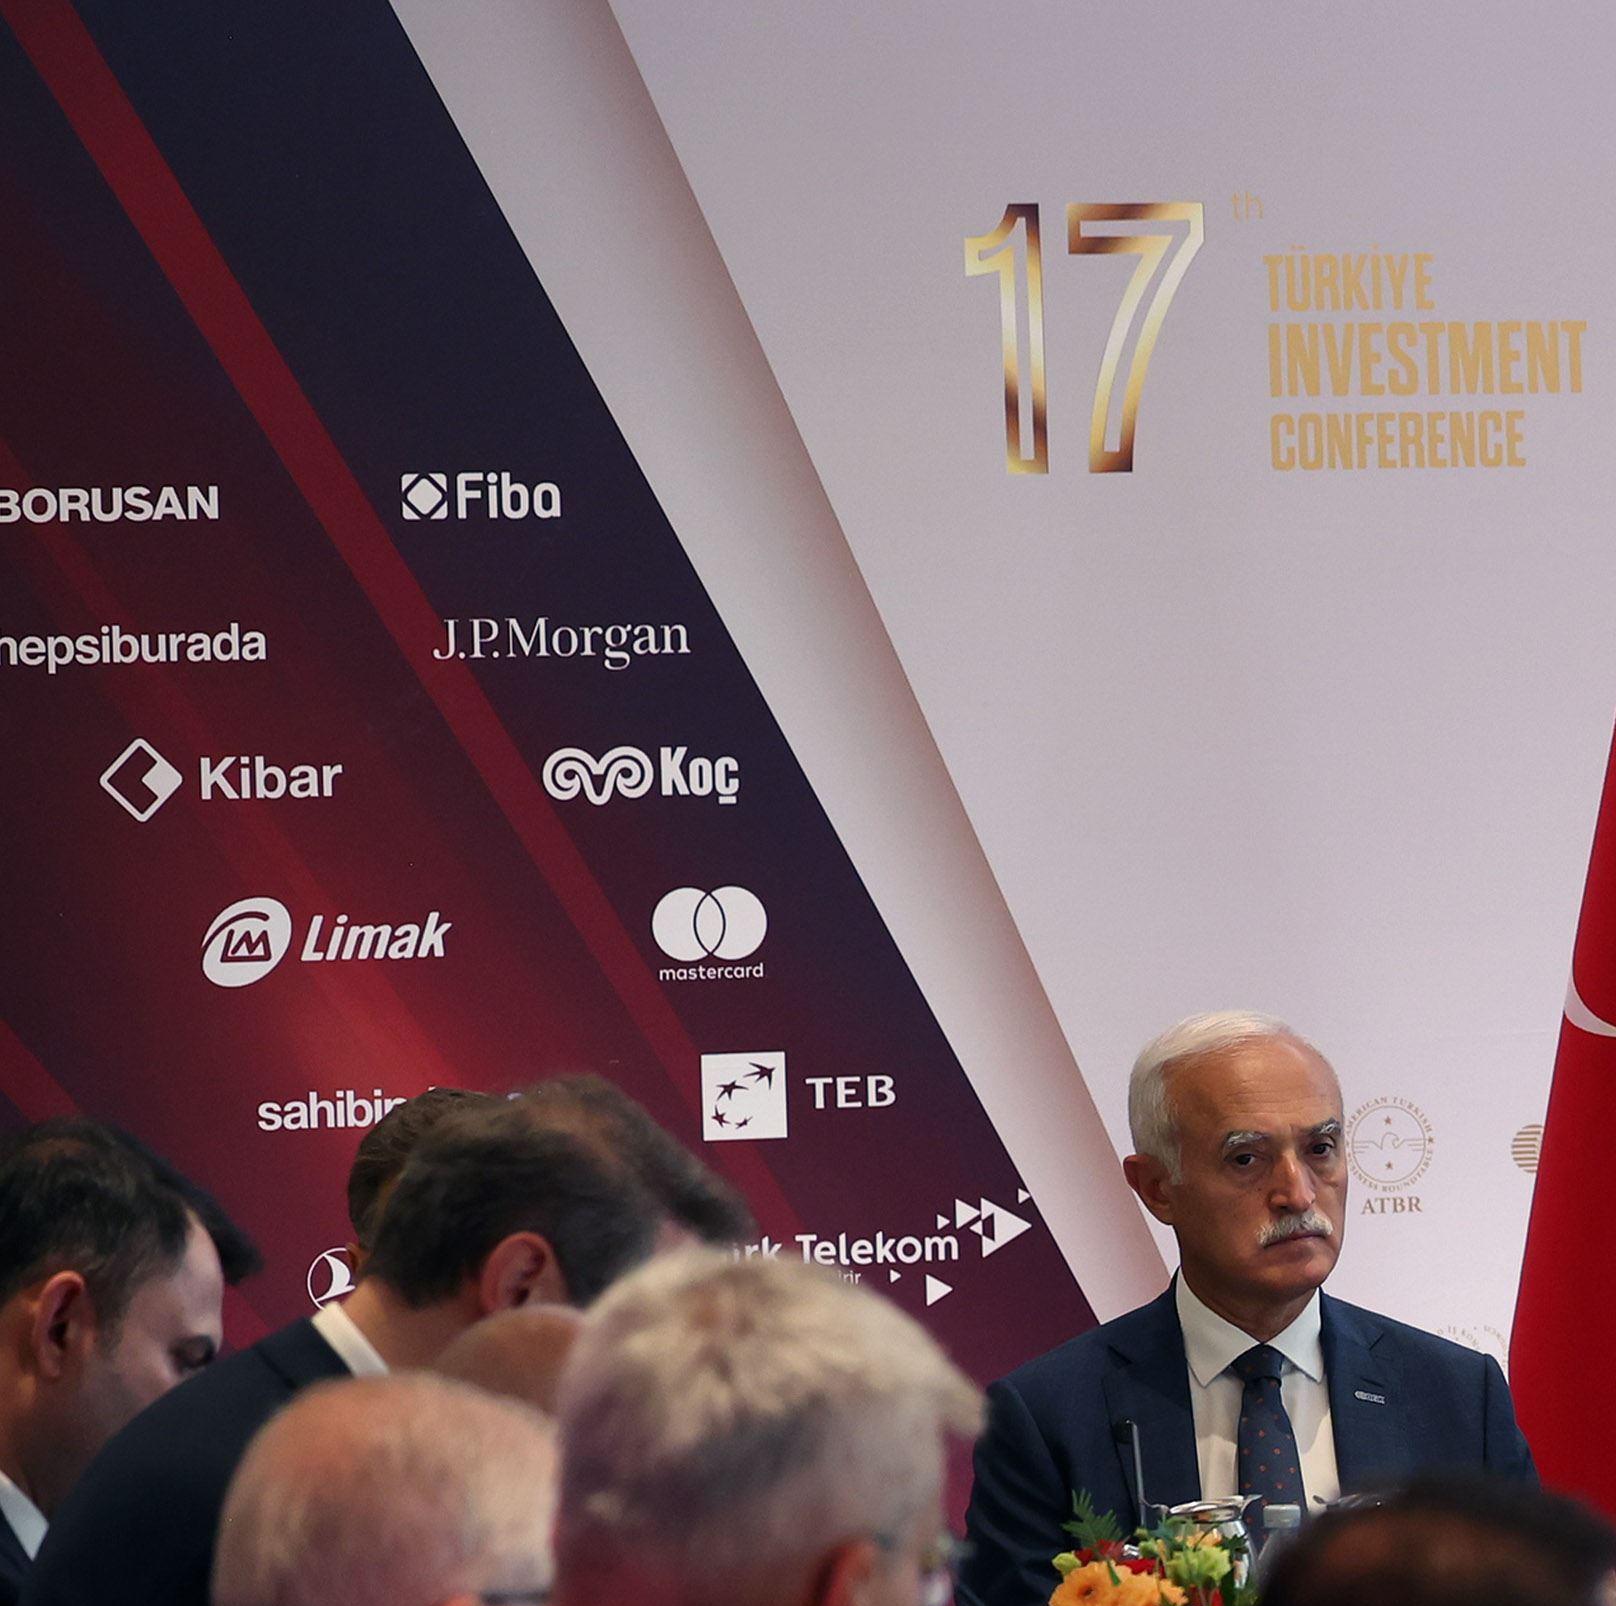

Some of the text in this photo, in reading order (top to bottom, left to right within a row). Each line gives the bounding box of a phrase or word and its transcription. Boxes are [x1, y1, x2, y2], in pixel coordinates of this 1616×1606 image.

[1262, 243, 1436, 312] TÜRKİYE
[964, 202, 1205, 475] 17
[1268, 320, 1587, 398] INVESTMENT
[1270, 410, 1527, 472] CONFERENCE
[456, 471, 562, 520] Fiba
[432, 616, 692, 671] J.P.Morgan
[200, 755, 344, 801] Kibar
[660, 745, 740, 805] Koç
[301, 911, 453, 962] Limak
[658, 963, 765, 981] mastercard
[805, 1074, 897, 1109] TEB
[1361, 1196, 1422, 1214] ATBR
[795, 1231, 959, 1266] Telekom
